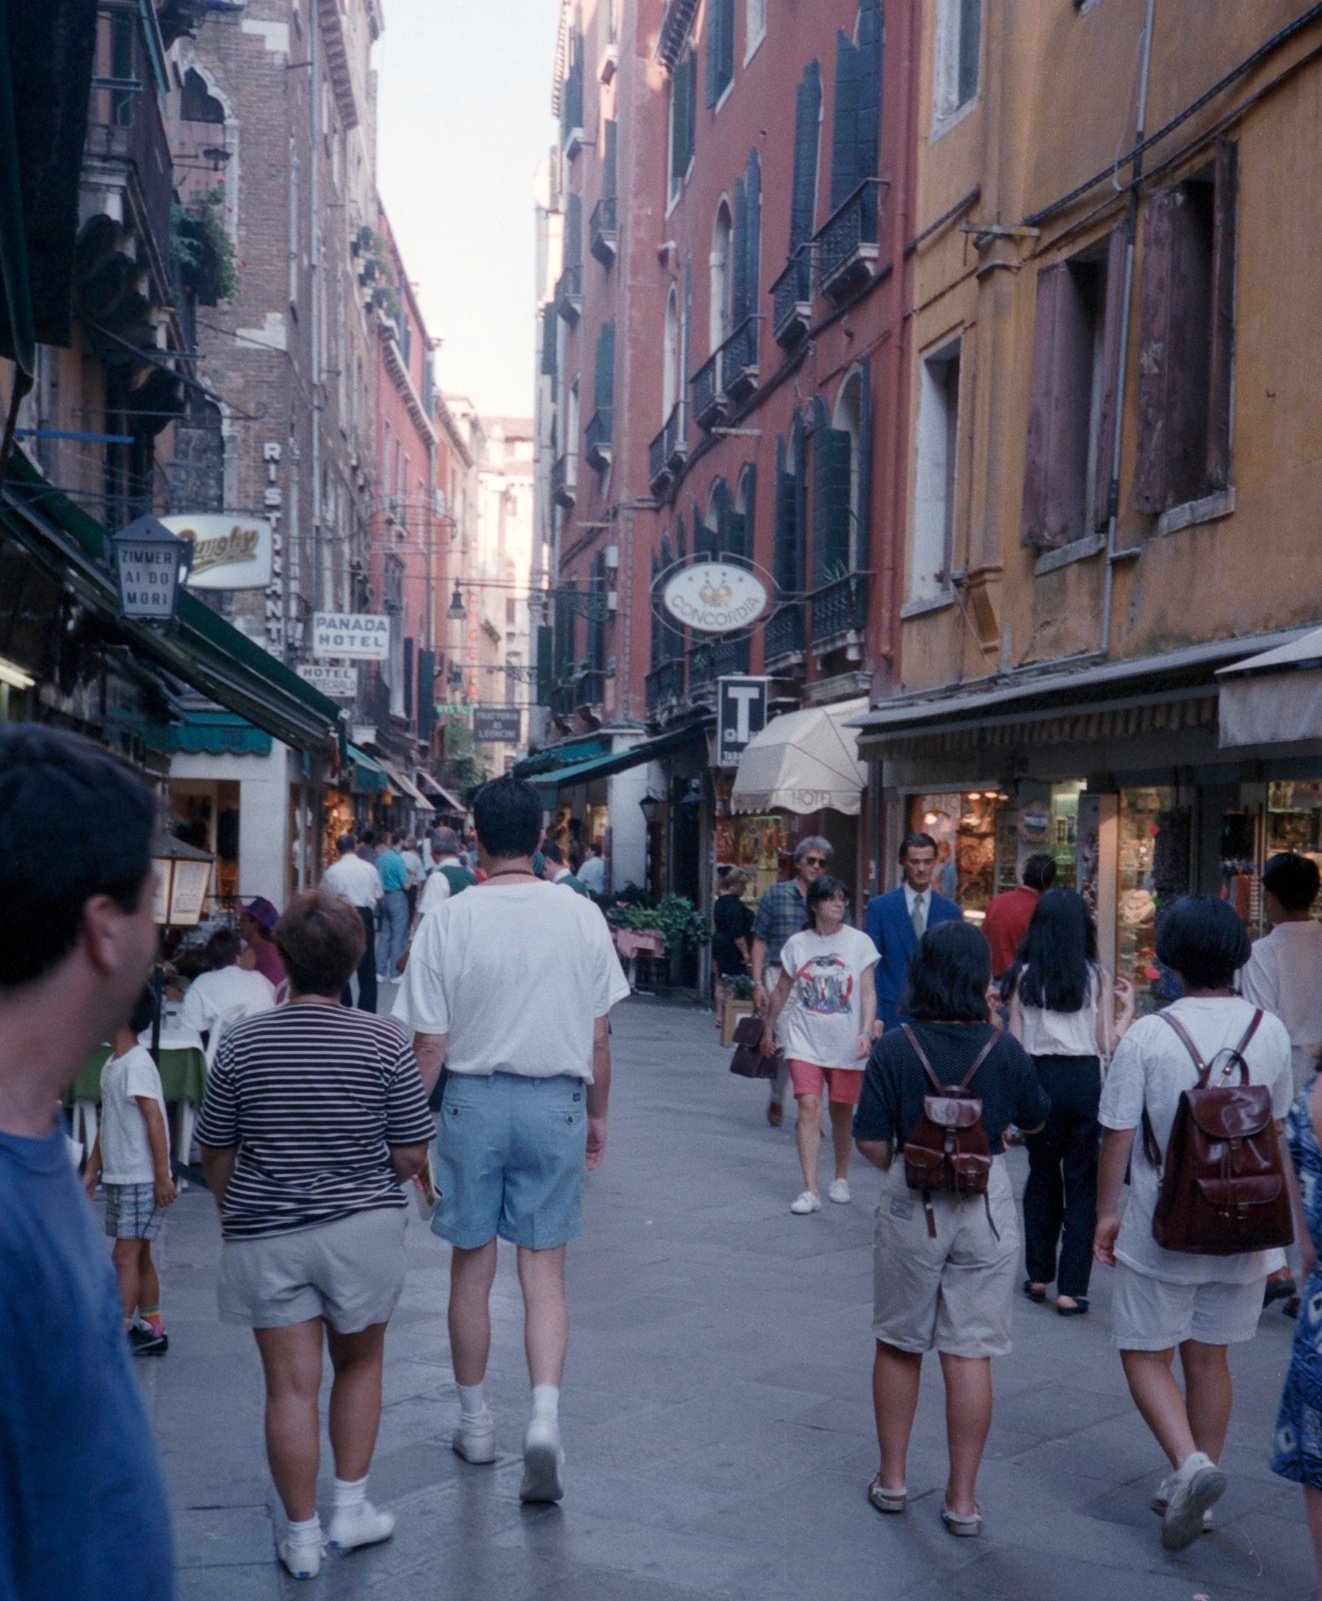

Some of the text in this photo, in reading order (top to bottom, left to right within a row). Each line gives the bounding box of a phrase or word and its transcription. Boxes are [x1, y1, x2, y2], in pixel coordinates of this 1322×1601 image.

[121, 551, 173, 565] ZIMMER
[126, 571, 169, 584] AI DO
[127, 591, 168, 605] MORI
[671, 595, 760, 626] CONCORDIA
[315, 617, 387, 632] PANADA
[318, 634, 384, 648] HOTEL
[303, 668, 352, 679] HOTEL
[727, 686, 760, 743] T
[792, 790, 834, 807] HOTEL
